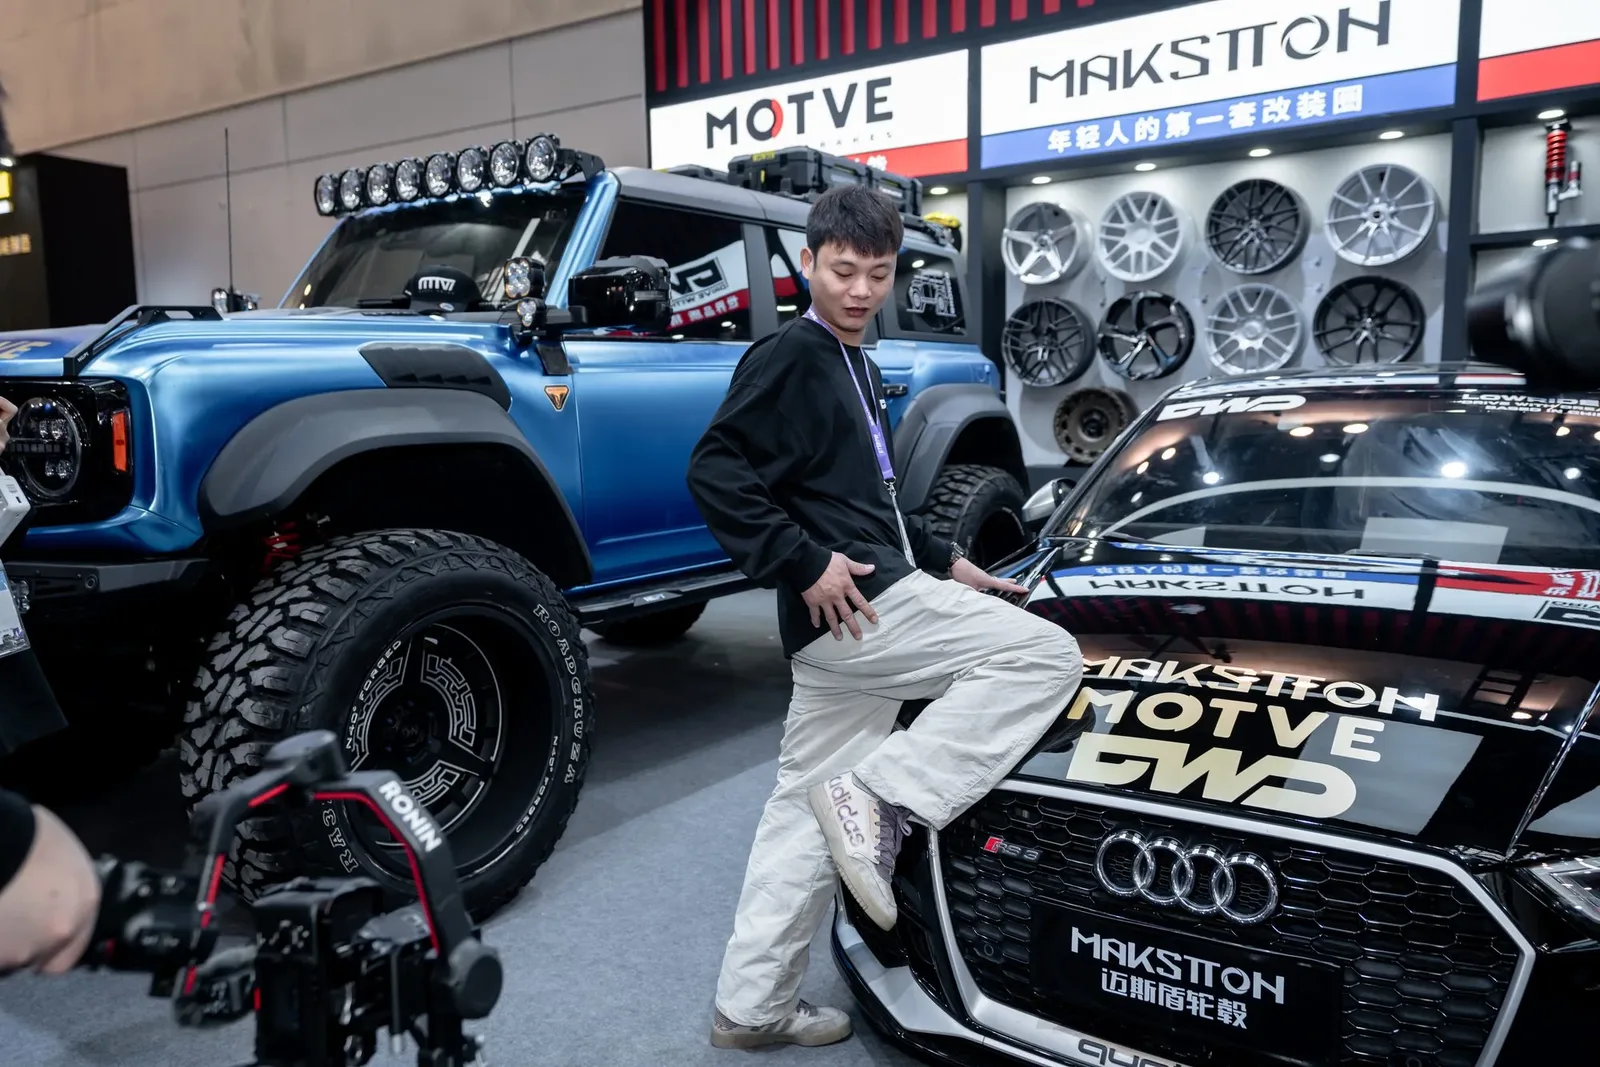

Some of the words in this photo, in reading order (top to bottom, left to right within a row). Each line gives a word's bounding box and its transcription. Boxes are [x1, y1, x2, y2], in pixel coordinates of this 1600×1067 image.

[706, 76, 893, 149] MOTVE
[358, 640, 402, 701] FORGED
[1066, 685, 1385, 763] MOTVE
[378, 779, 443, 853] RONIN
[829, 775, 865, 848] adidas
